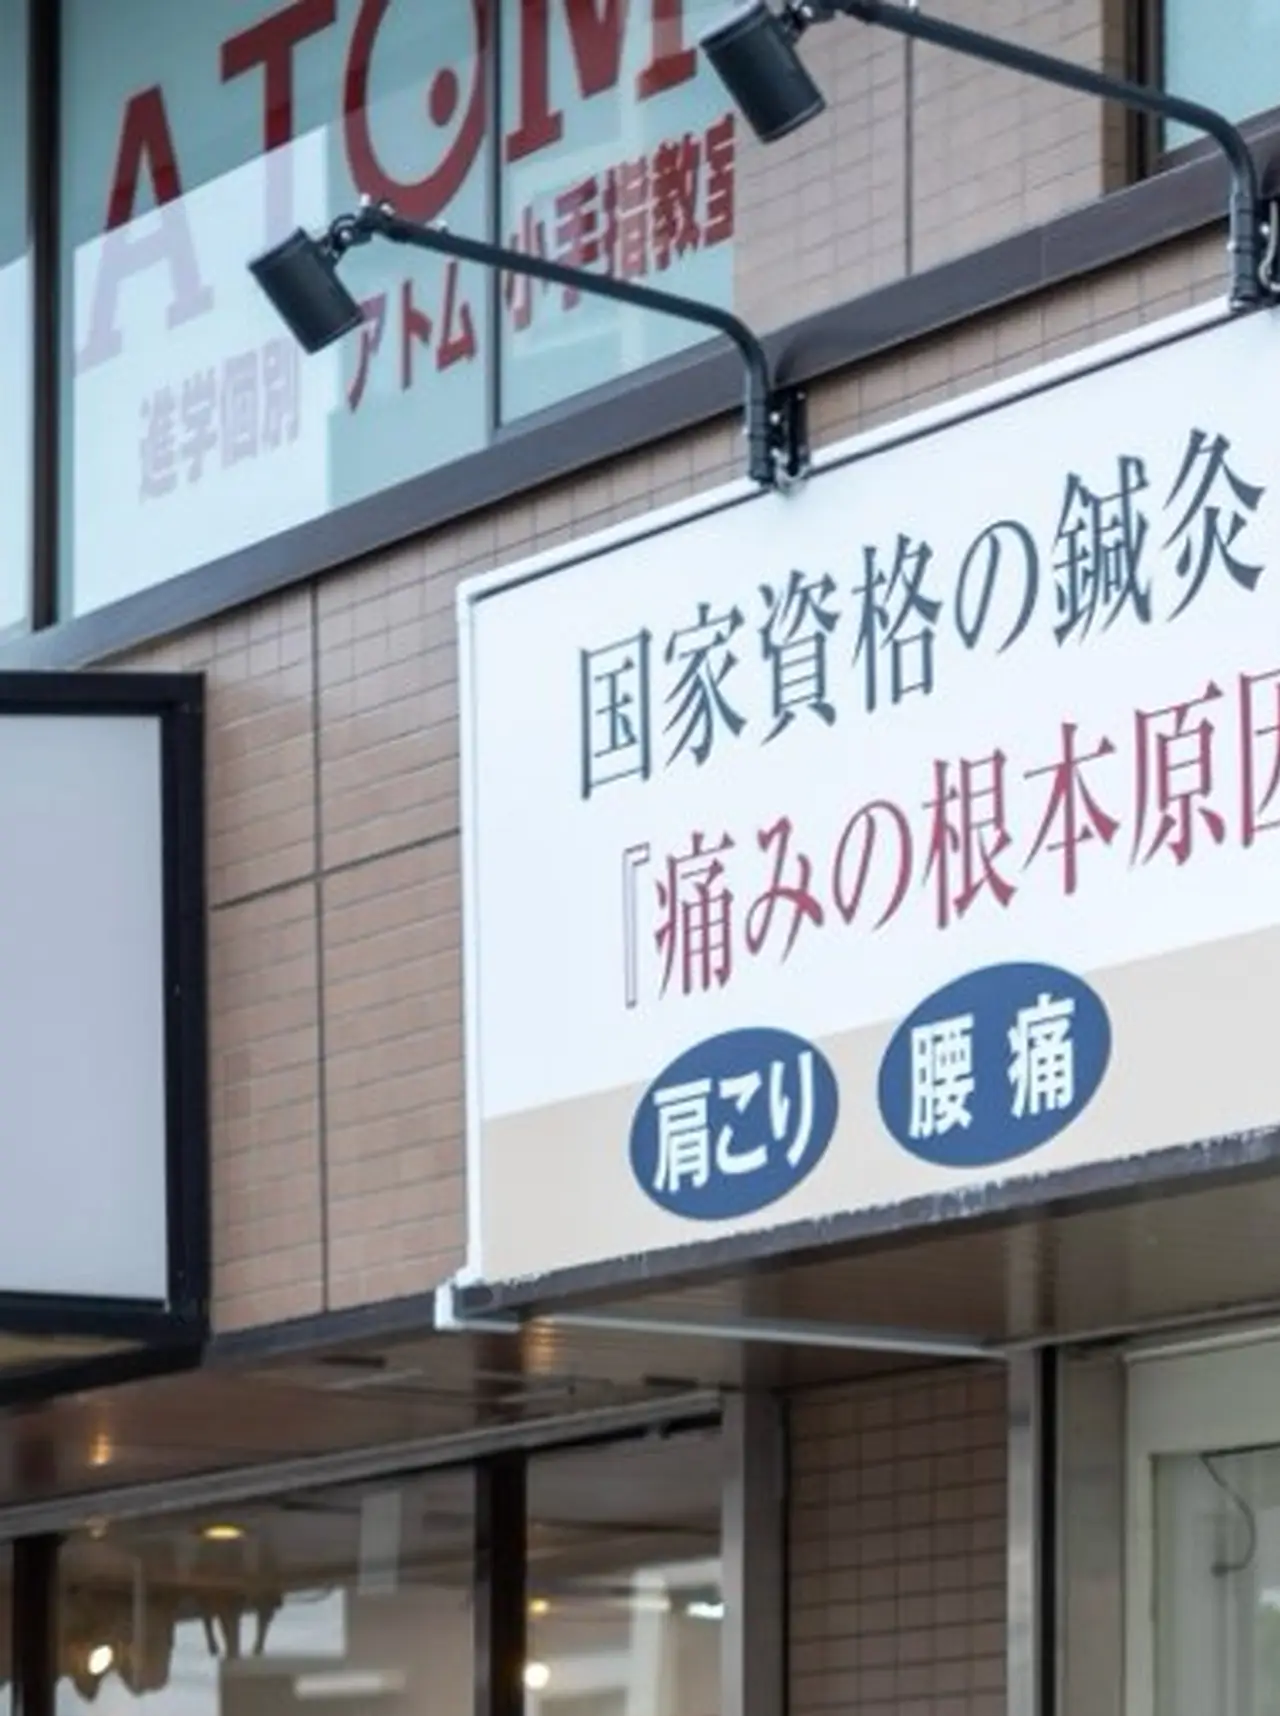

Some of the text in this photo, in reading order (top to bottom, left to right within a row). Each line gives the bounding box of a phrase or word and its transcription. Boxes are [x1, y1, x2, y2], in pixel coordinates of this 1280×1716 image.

[137, 112, 735, 504] 進学個別 アトム 小手指教室
[651, 1050, 816, 1195] 肩こり
[907, 994, 1077, 1139] 腰痛
